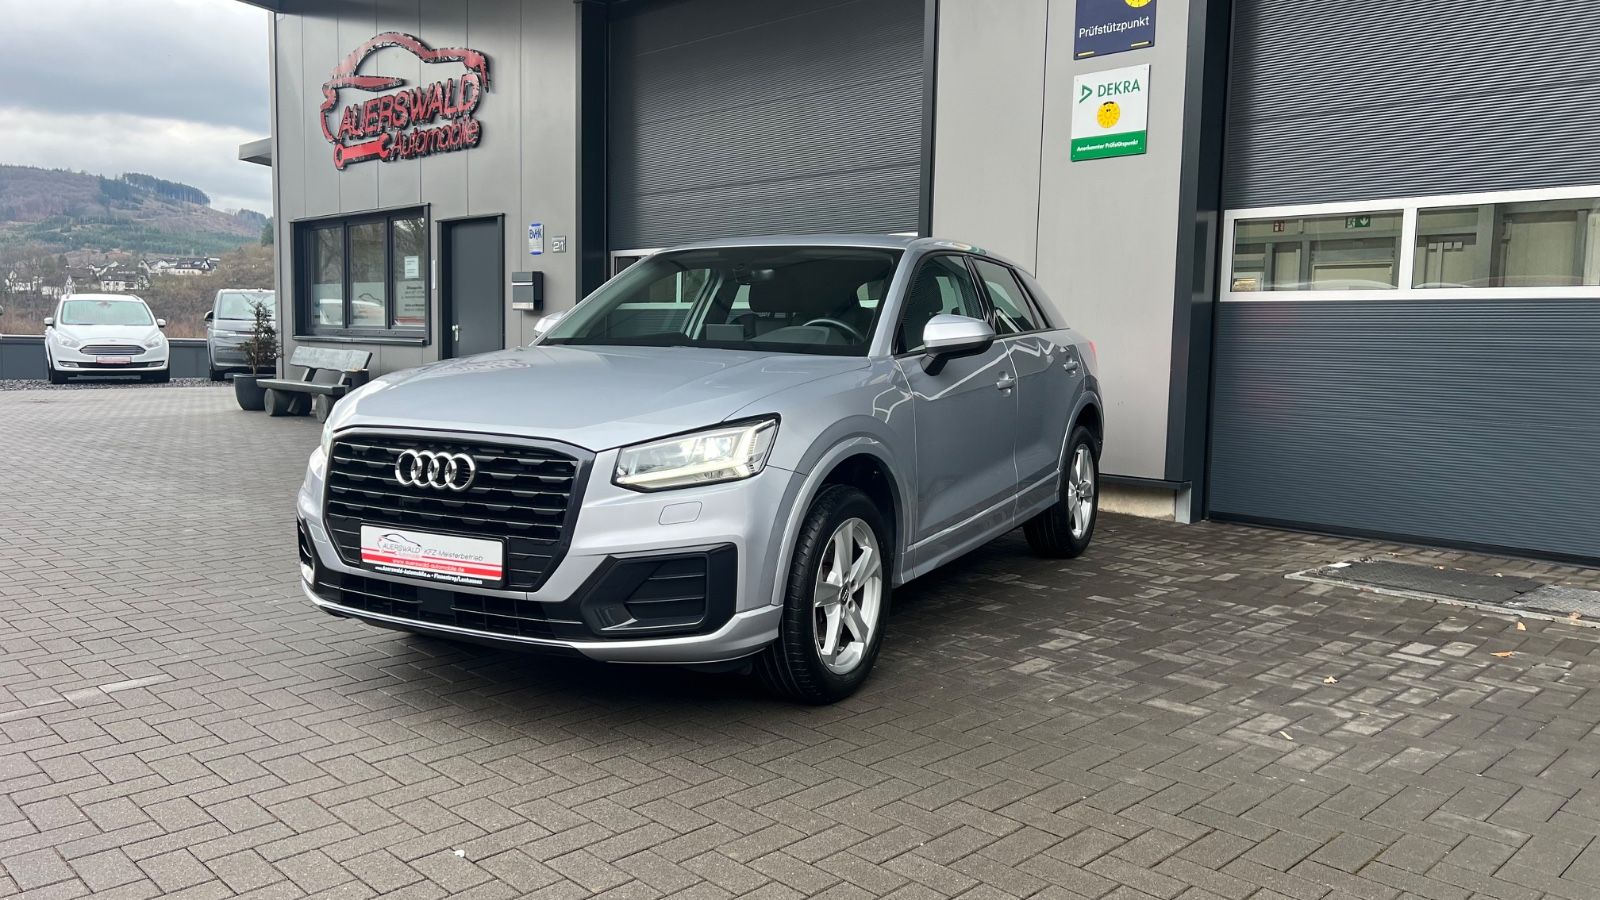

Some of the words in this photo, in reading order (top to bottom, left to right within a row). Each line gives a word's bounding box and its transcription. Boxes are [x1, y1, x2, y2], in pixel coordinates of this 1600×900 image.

[1079, 16, 1150, 38] Prüfstützpunkt
[1097, 78, 1141, 98] DEKRA
[337, 73, 482, 143] AUERSWALD
[389, 116, 483, 161] Automobile
[553, 241, 564, 252] 21
[382, 543, 421, 554] AUERSWALD
